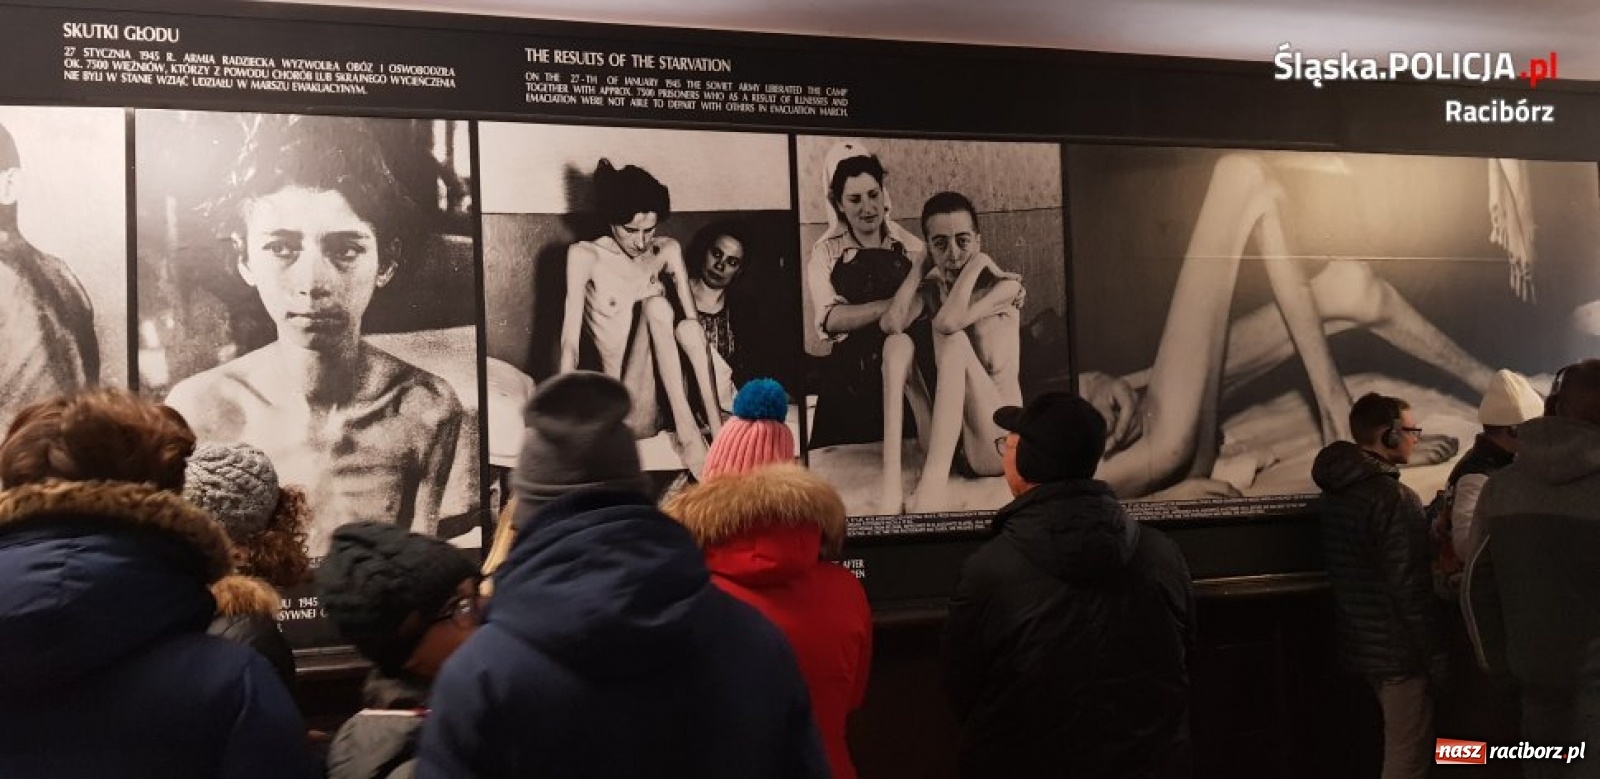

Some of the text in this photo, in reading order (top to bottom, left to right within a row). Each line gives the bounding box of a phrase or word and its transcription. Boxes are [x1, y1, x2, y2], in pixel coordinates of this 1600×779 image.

[62, 22, 180, 43] SKUTKI GŁODU
[63, 46, 76, 56] 27
[83, 47, 131, 59] STYCZNIA
[139, 50, 160, 61] 1945
[183, 53, 216, 65] ARMIA
[222, 55, 275, 68] RADZIECKA
[345, 60, 374, 73] OBÓZ
[64, 58, 83, 69] OK.
[86, 59, 109, 71] 7500
[170, 62, 210, 75] KTÓRZY
[213, 66, 220, 76] Z
[223, 66, 269, 79] POWODU
[271, 68, 313, 82] CHORÓB
[314, 71, 332, 82] LUB
[524, 48, 732, 73] THE RESULTS OF THE STARVATION
[63, 70, 80, 81] NIE
[82, 71, 103, 82] BYLI
[106, 72, 118, 82] W
[121, 73, 152, 84] STANIE
[236, 79, 248, 89] W
[251, 80, 290, 91] MARSZU
[525, 71, 539, 82] ON
[544, 72, 560, 82] THE
[606, 75, 619, 85] OF
[687, 80, 702, 90] THE
[705, 80, 733, 91] SOVIET
[765, 83, 803, 95] LIBERATED
[525, 82, 569, 93] TOGETHER
[573, 84, 596, 95] WITH
[657, 88, 700, 100] PRISONERS
[703, 91, 725, 101] WHO
[728, 92, 739, 102] AS
[525, 92, 577, 105] EMACIATION
[580, 95, 604, 106] WERE
[608, 96, 625, 107] NOT
[653, 98, 664, 108] TO
[700, 101, 722, 112] WITH
[725, 102, 755, 113] OTHERS
